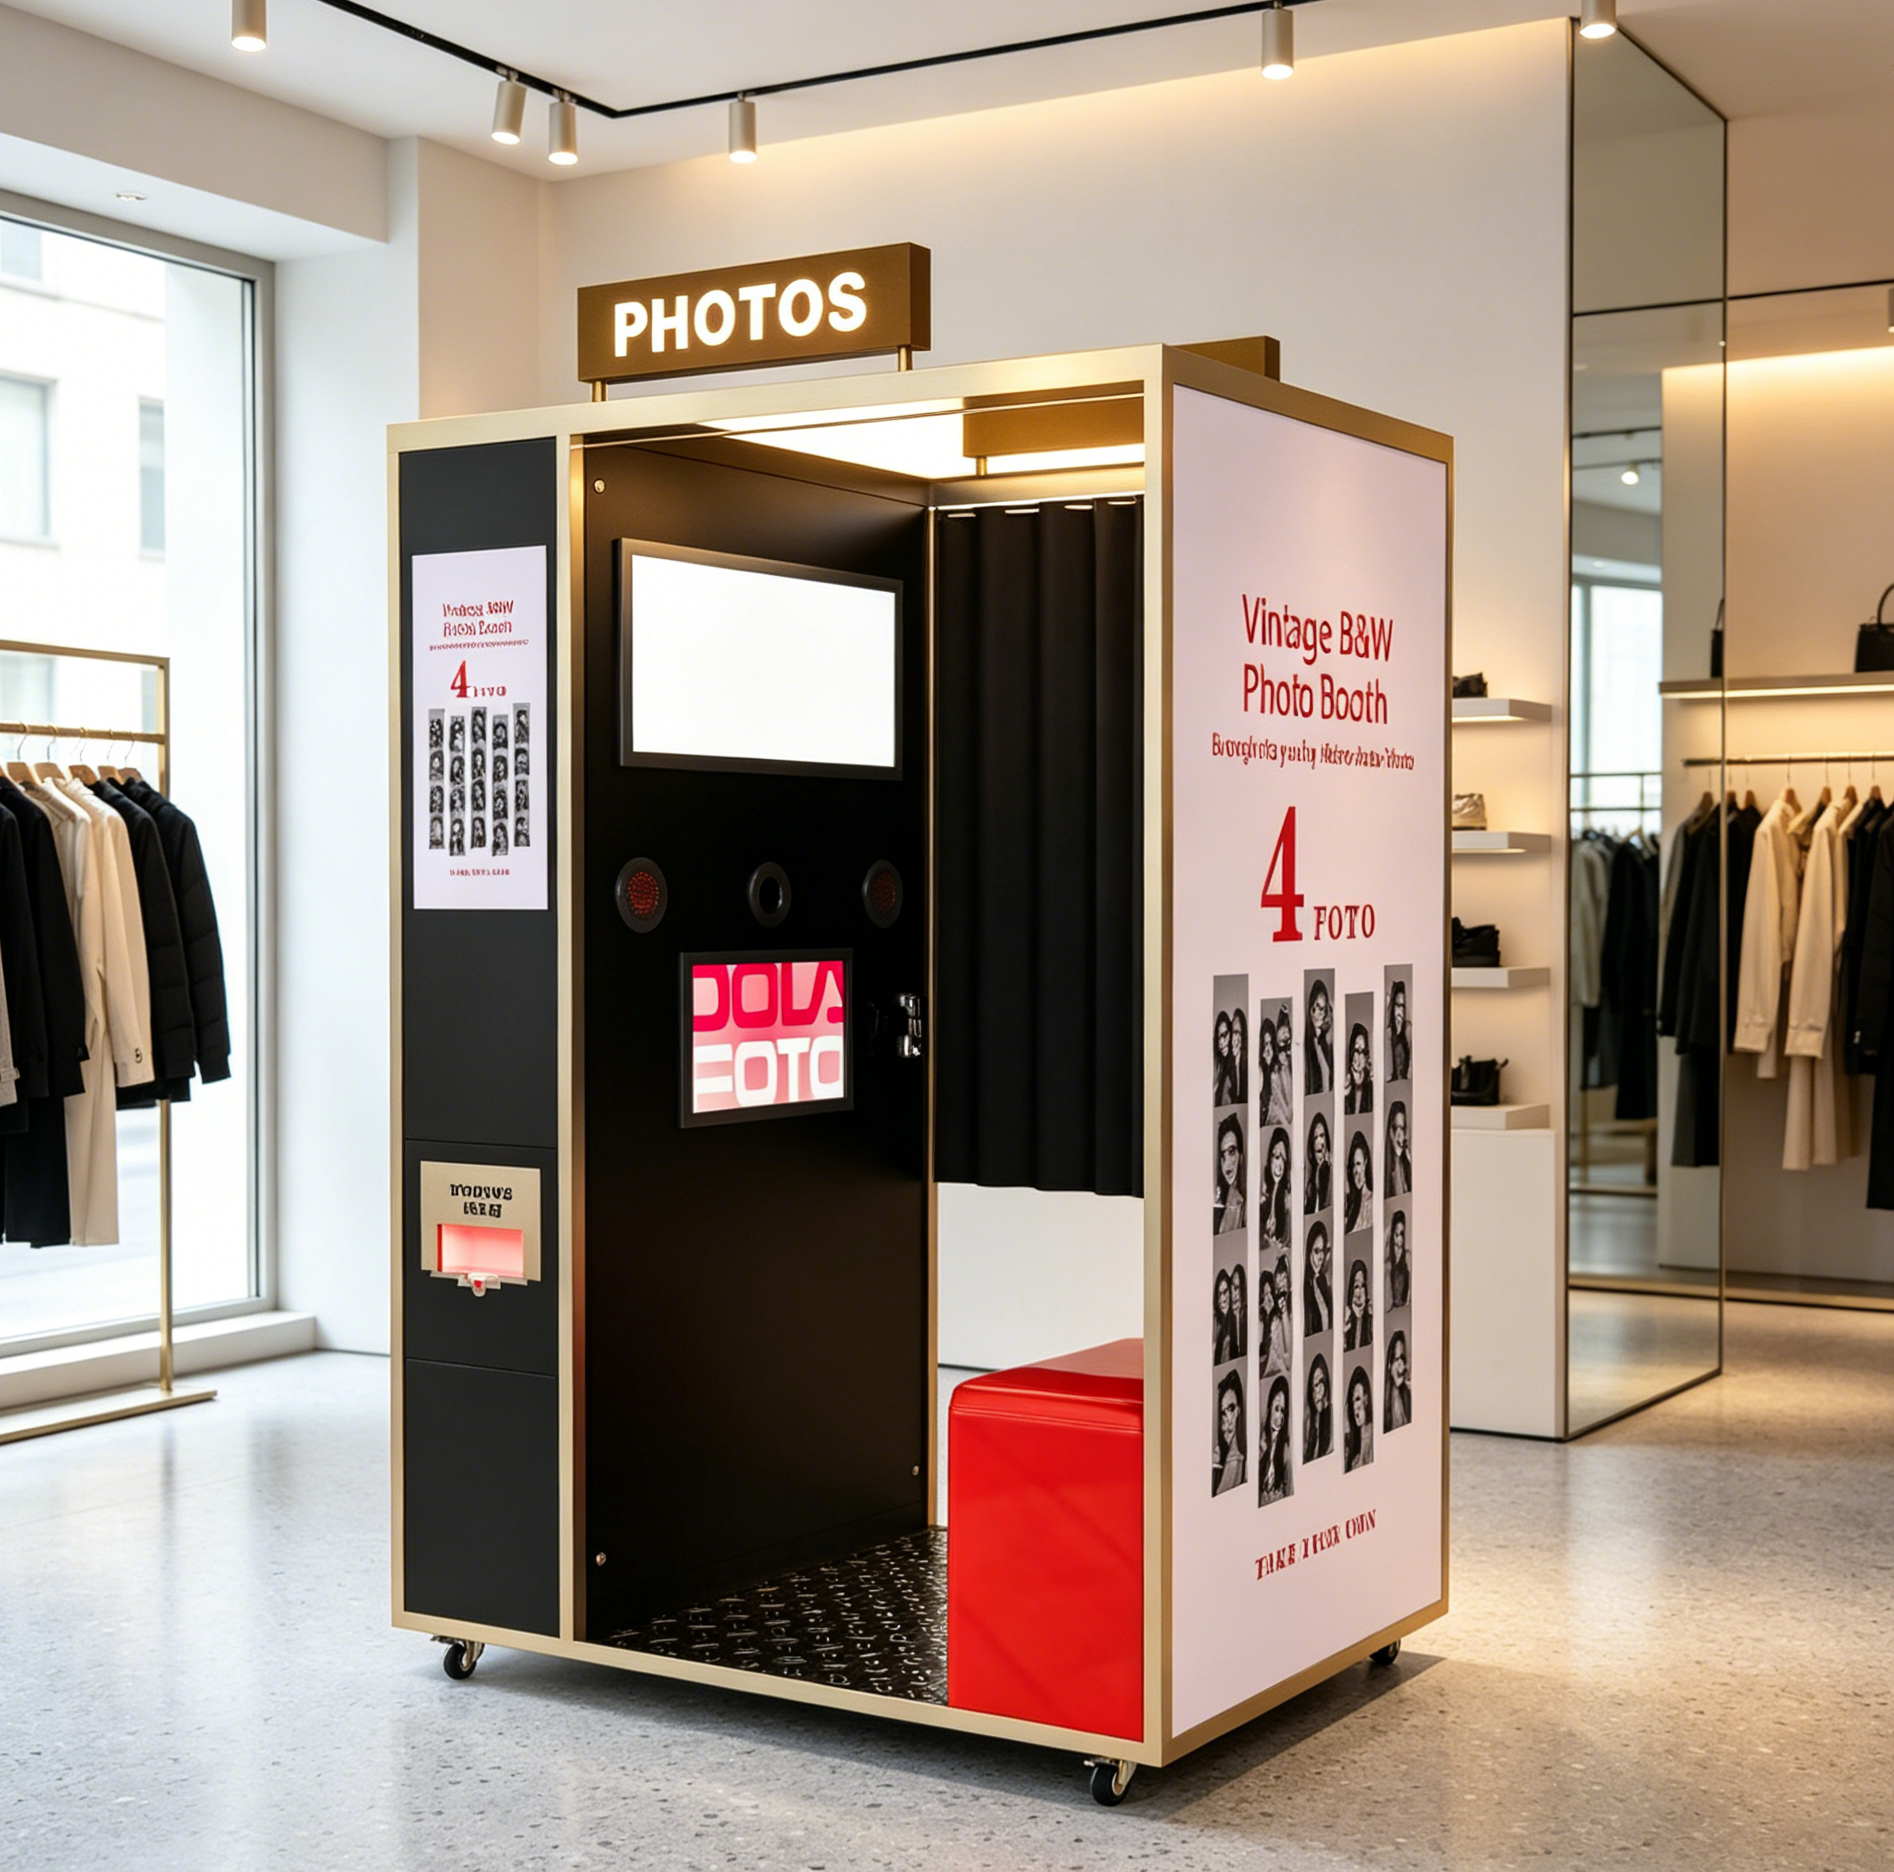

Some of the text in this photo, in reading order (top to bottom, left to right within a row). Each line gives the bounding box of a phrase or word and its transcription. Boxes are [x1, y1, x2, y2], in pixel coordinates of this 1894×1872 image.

[614, 271, 867, 357] PHOTOS
[1242, 594, 1393, 665] Vintage B&W
[450, 660, 469, 698] 4
[1244, 663, 1387, 724] Photo Booth
[1261, 806, 1375, 942] 4 FOTO
